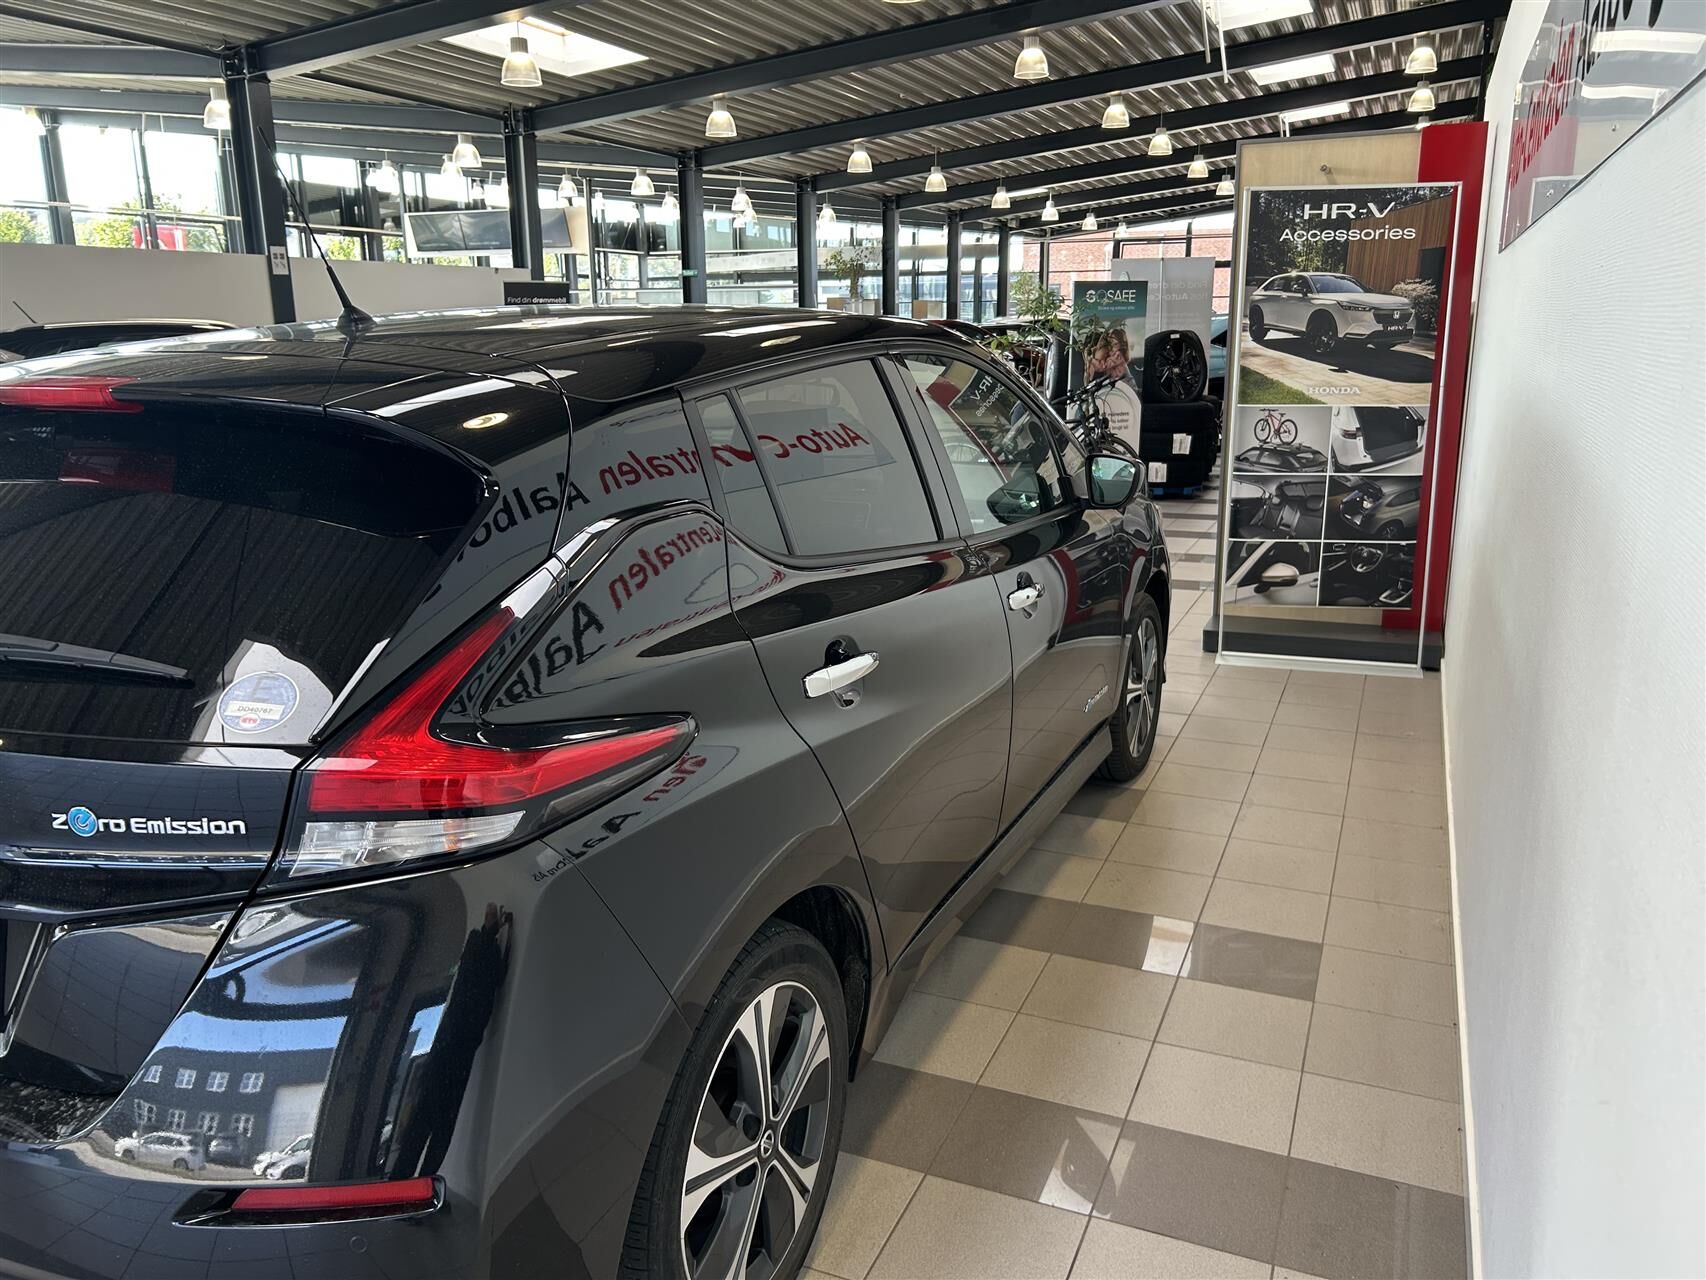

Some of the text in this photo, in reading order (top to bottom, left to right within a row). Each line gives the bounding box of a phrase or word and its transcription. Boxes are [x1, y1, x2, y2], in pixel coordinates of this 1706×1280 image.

[1303, 201, 1396, 220] HR-V
[1279, 224, 1416, 242] Accessories
[507, 296, 521, 304] Find
[1306, 385, 1361, 395] HONDA
[131, 817, 247, 835] Emission
